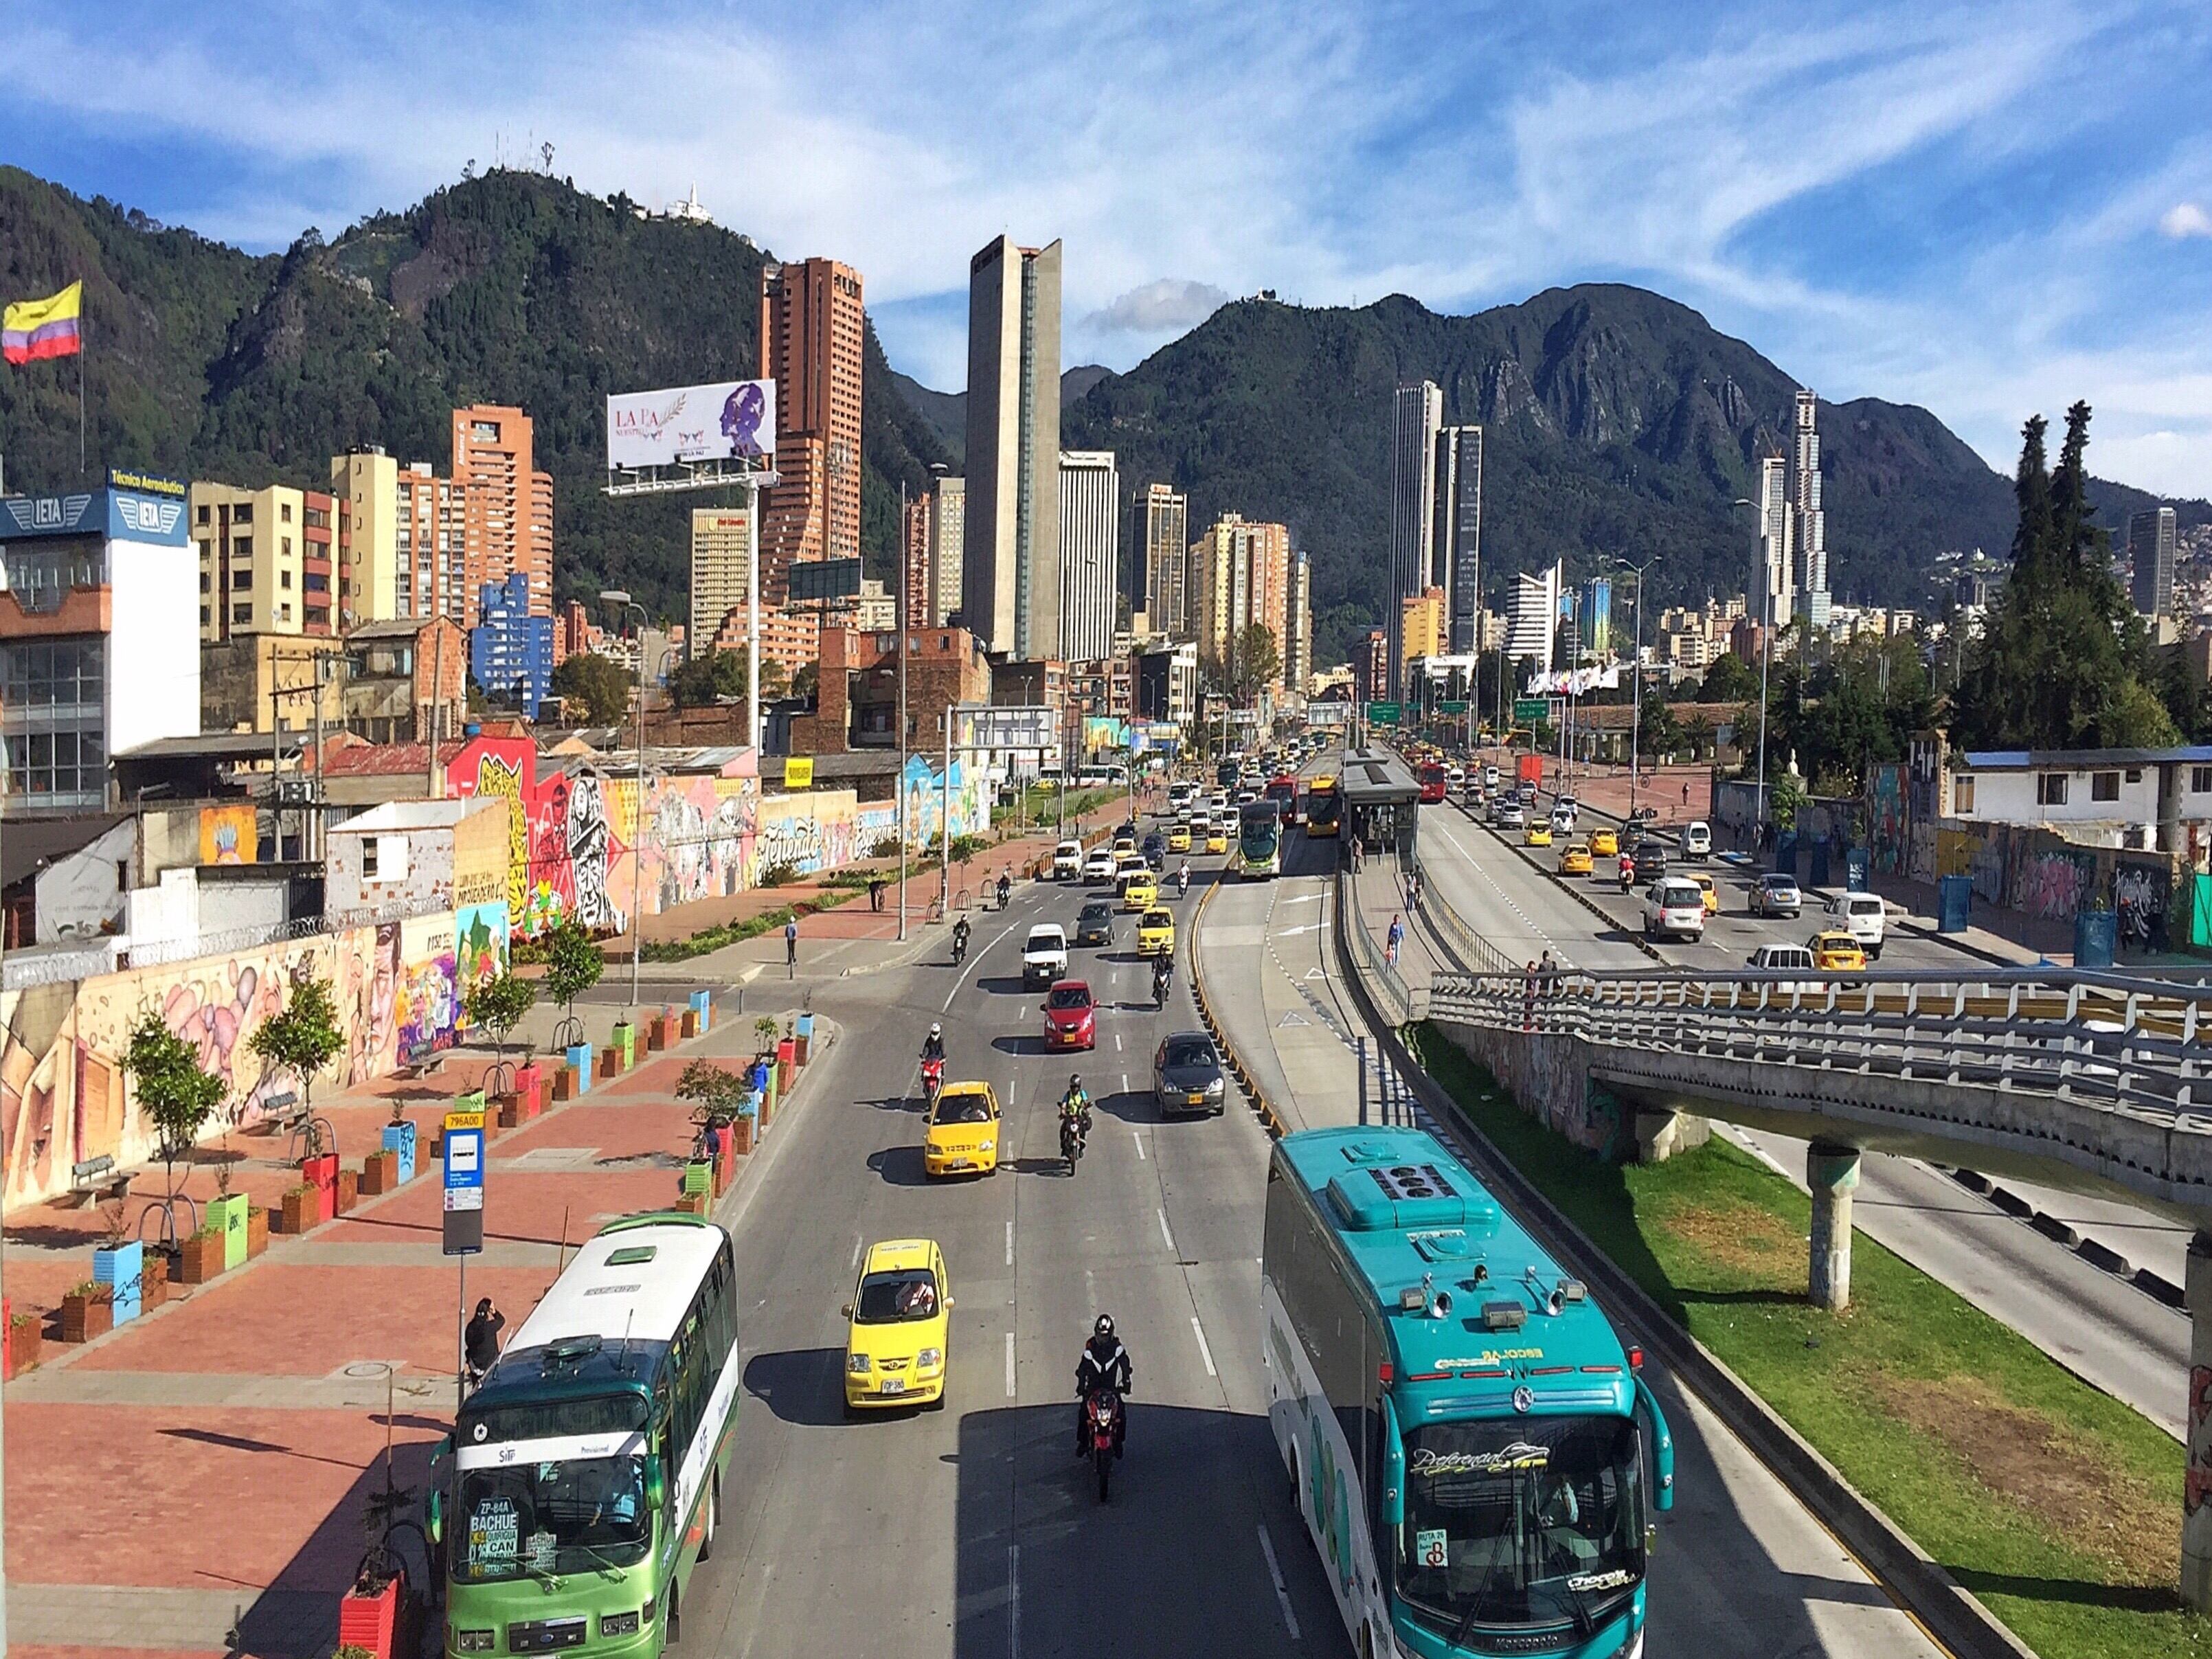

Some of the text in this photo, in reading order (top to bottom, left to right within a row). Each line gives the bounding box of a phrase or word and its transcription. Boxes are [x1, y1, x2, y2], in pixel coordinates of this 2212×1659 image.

[616, 410, 635, 427] LA
[111, 469, 185, 496] Técnico Aeronáutico
[36, 498, 61, 524] IETA
[139, 501, 159, 528] IETA
[450, 1116, 479, 1127] 796A00
[471, 1513, 517, 1532] BACHUE
[1419, 1532, 1436, 1542] RUTA
[490, 1541, 514, 1553] CAN
